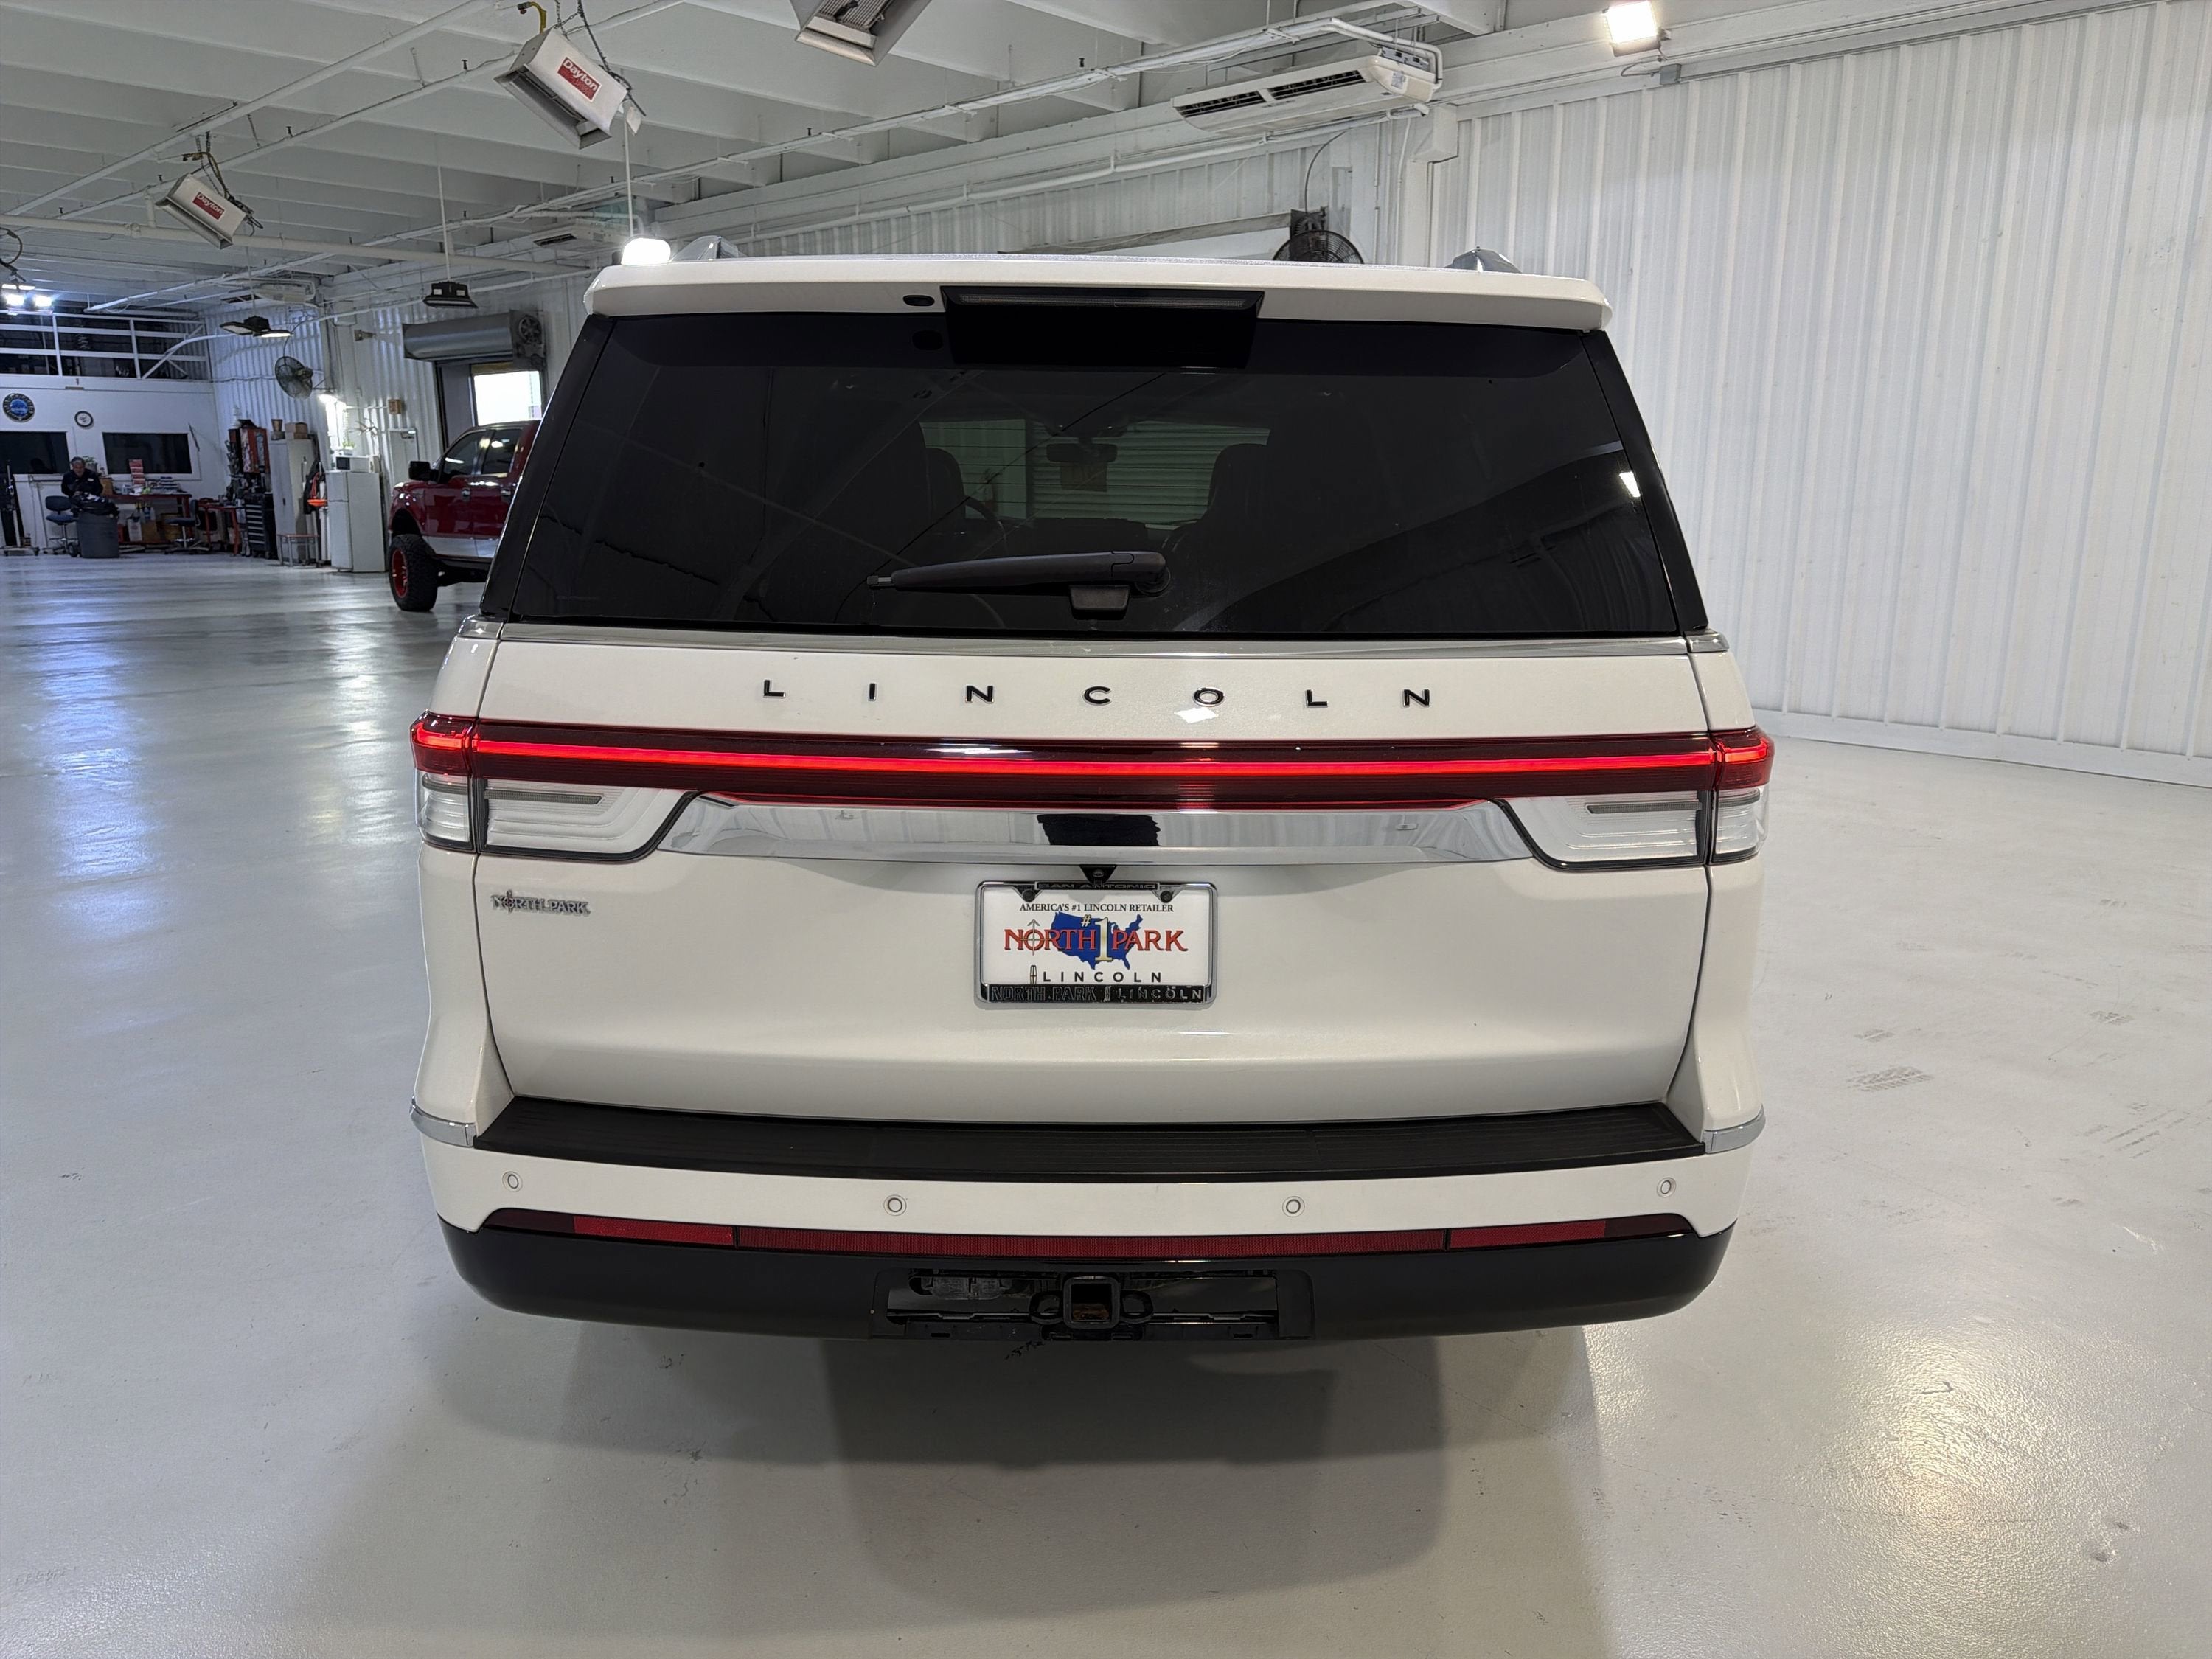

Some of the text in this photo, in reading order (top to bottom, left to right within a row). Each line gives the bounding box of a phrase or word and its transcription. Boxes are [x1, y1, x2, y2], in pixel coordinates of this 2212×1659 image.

[563, 60, 598, 91] Dayton
[197, 194, 223, 214] Dayton
[763, 679, 1431, 707] LINCOLN
[490, 889, 591, 916] NORTH PARK
[1020, 903, 1174, 912] AMERICA'S #1 LINCOLN RETAILER
[1004, 929, 1189, 951] NORTH PARK
[1043, 971, 1161, 983] LINCOLN
[991, 986, 1202, 1001] NORTH PARK LINCOLN
